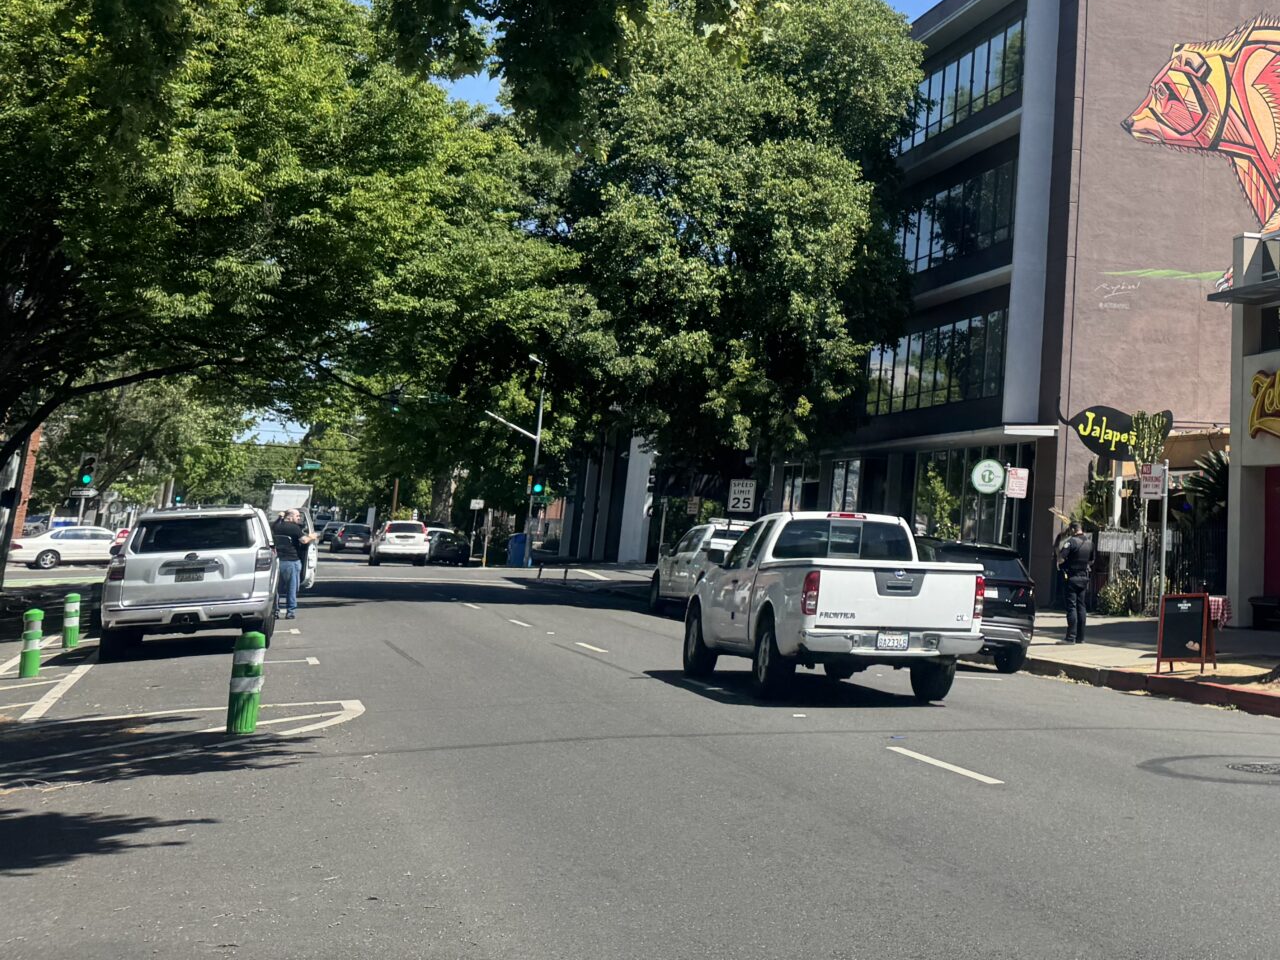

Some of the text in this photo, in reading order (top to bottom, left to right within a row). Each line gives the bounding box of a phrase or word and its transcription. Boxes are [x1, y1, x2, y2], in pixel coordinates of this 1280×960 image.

[1142, 465, 1151, 474] NO
[731, 497, 751, 509] 25
[819, 611, 856, 619] FRONTIER
